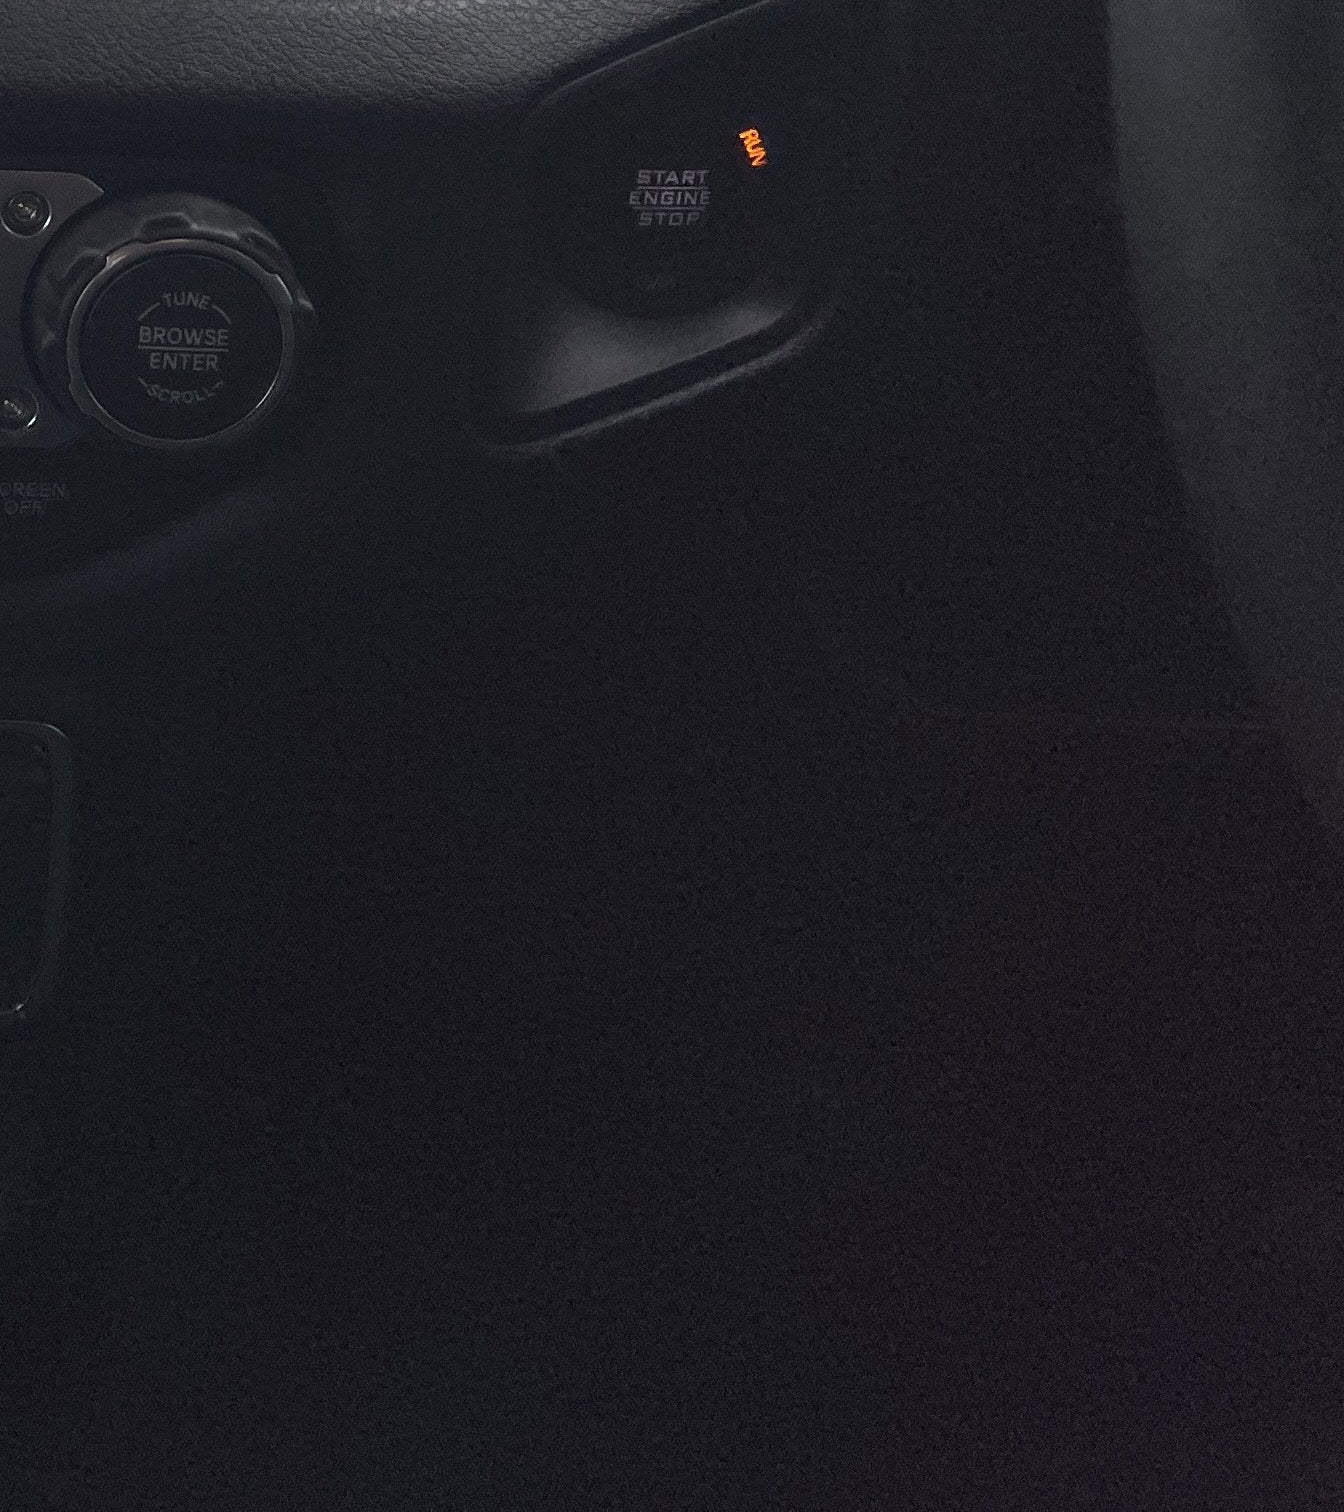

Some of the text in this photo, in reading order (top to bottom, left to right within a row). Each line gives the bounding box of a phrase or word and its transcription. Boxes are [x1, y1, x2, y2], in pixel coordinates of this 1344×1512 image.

[738, 126, 768, 167] RUN
[637, 169, 710, 185] START
[629, 190, 712, 206] ENGINE
[639, 211, 701, 226] STOP
[162, 291, 211, 310] TUNE
[139, 325, 229, 346] BROWSE
[150, 352, 218, 371] ENTER
